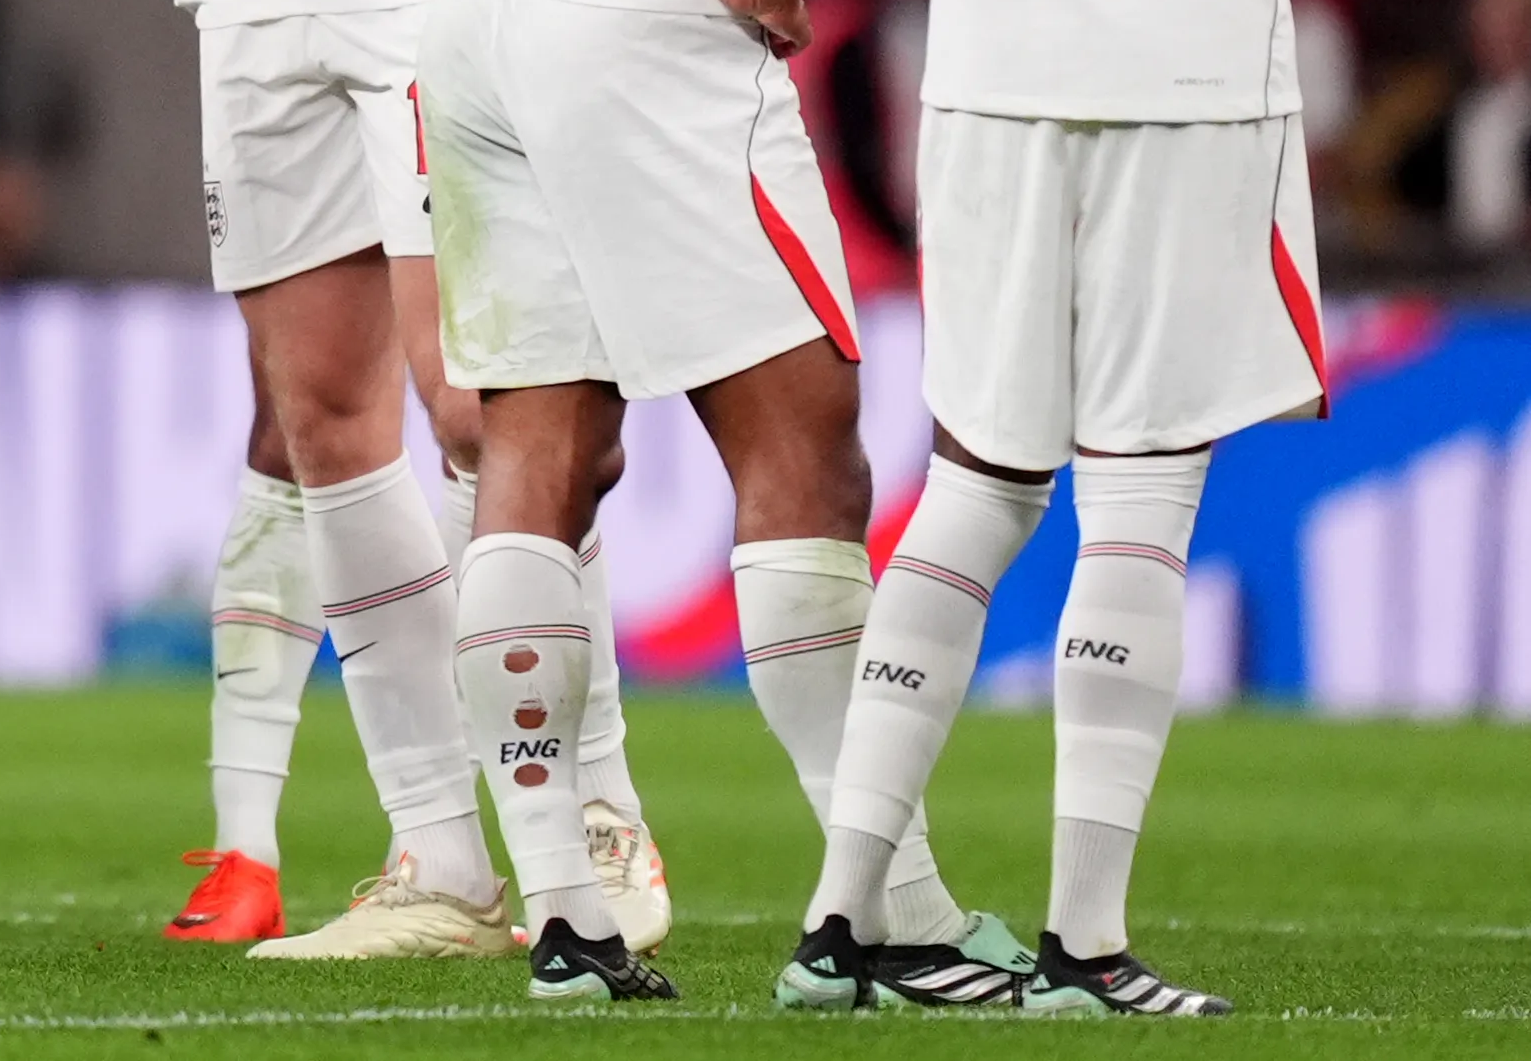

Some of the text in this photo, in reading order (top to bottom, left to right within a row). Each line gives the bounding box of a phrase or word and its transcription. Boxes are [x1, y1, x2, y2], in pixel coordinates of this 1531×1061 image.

[1065, 638, 1130, 666] ENG
[862, 660, 926, 691] ENG
[500, 737, 562, 765] ENG
